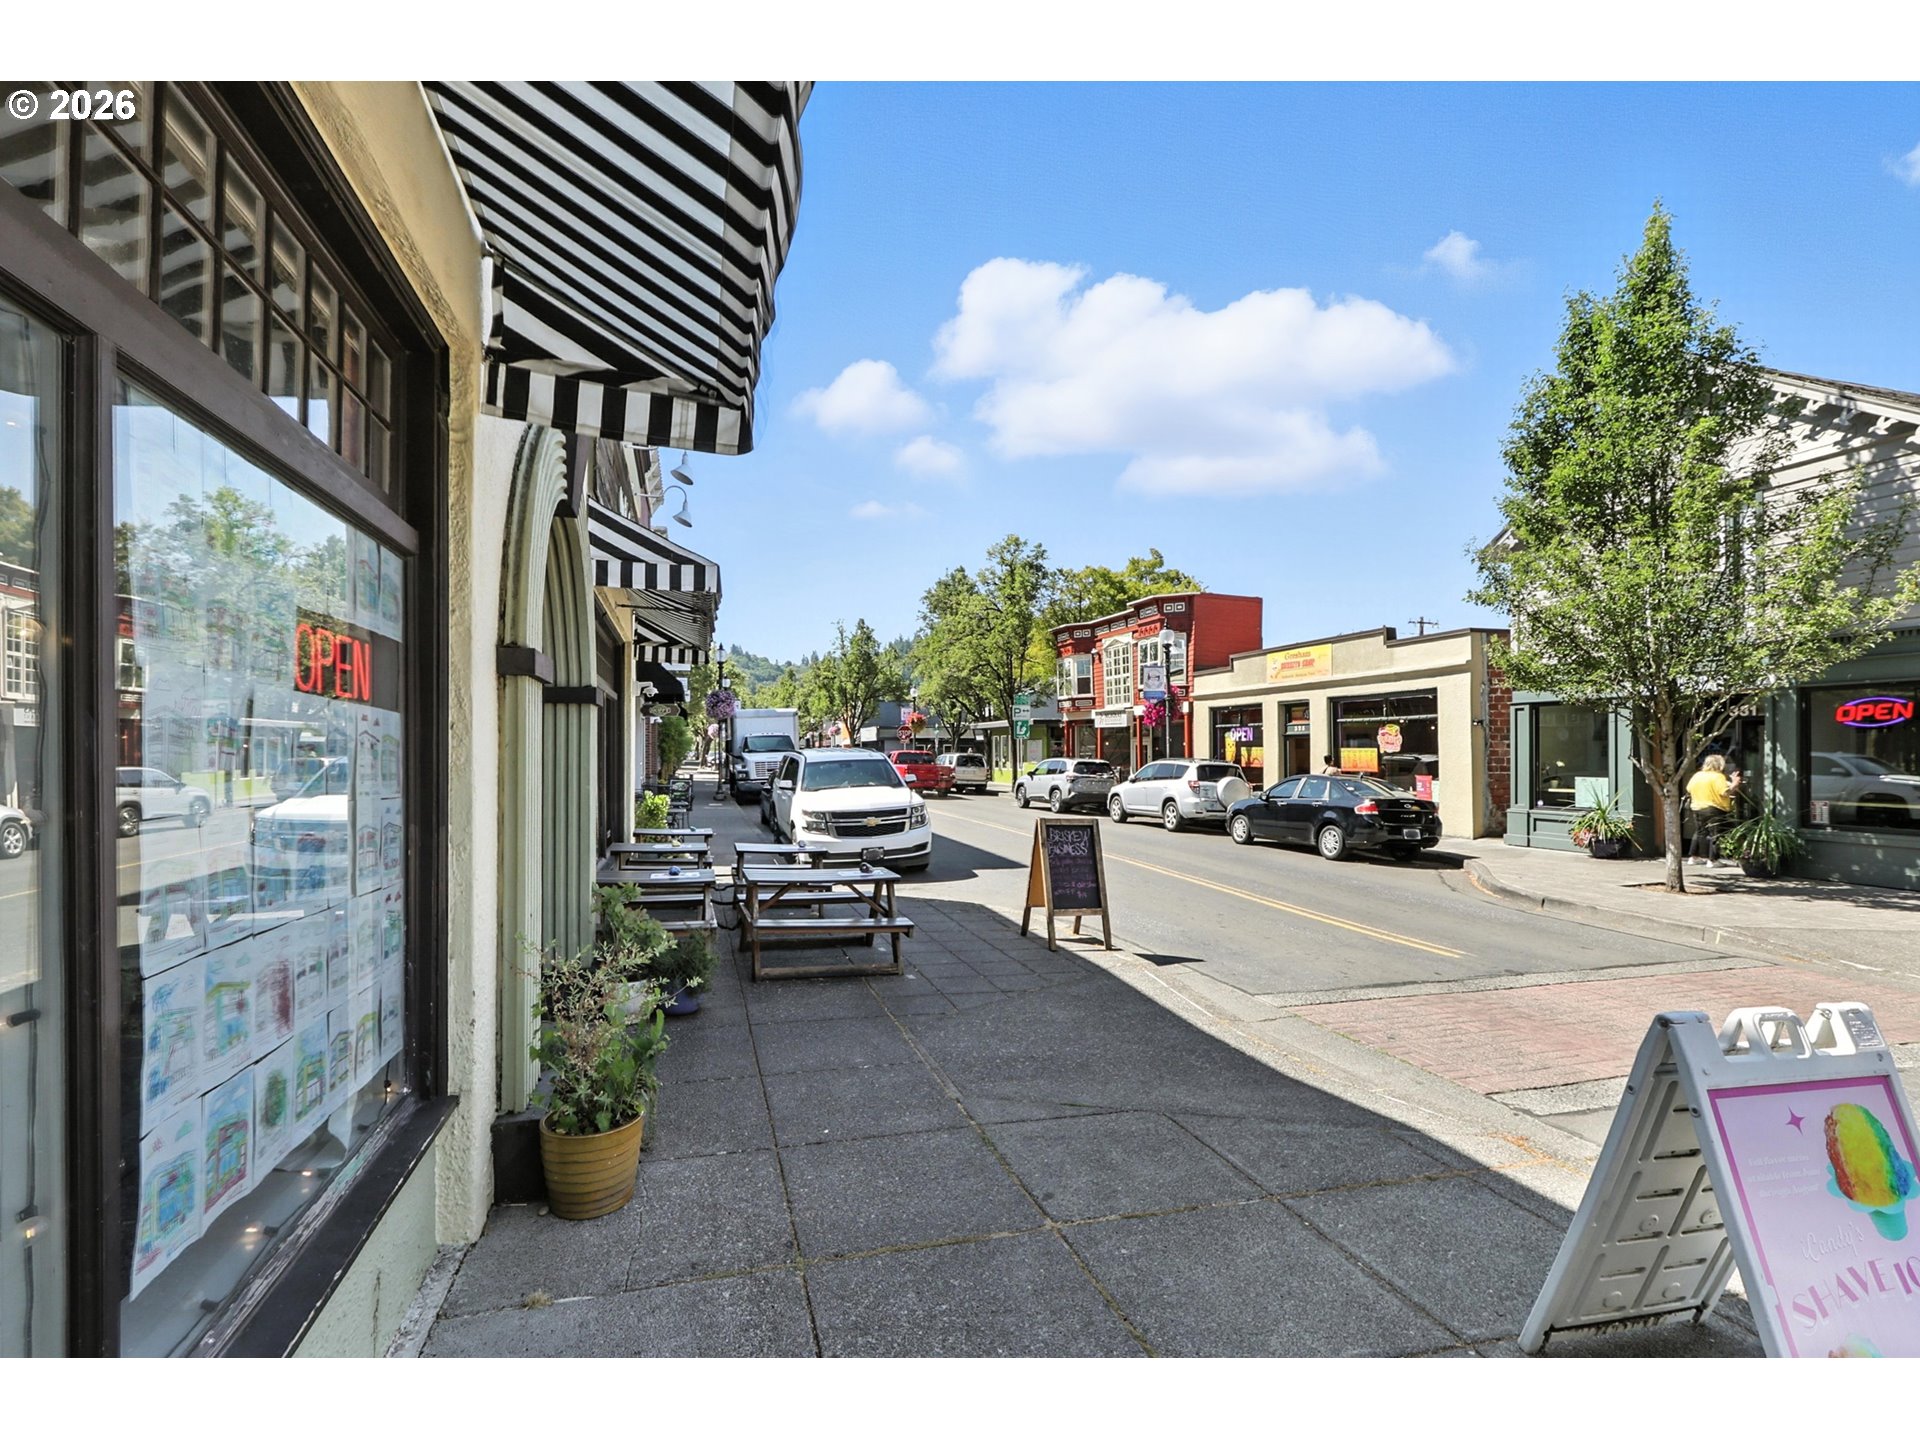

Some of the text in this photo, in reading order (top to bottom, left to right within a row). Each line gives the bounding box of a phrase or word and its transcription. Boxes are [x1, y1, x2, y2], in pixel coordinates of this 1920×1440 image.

[295, 623, 370, 701] OPEN
[1729, 705, 1757, 717] 331
[1835, 701, 1914, 723] OPEN
[898, 731, 912, 739] STOP
[1230, 727, 1253, 741] OPEN
[1792, 1257, 1896, 1330] SHAVE
